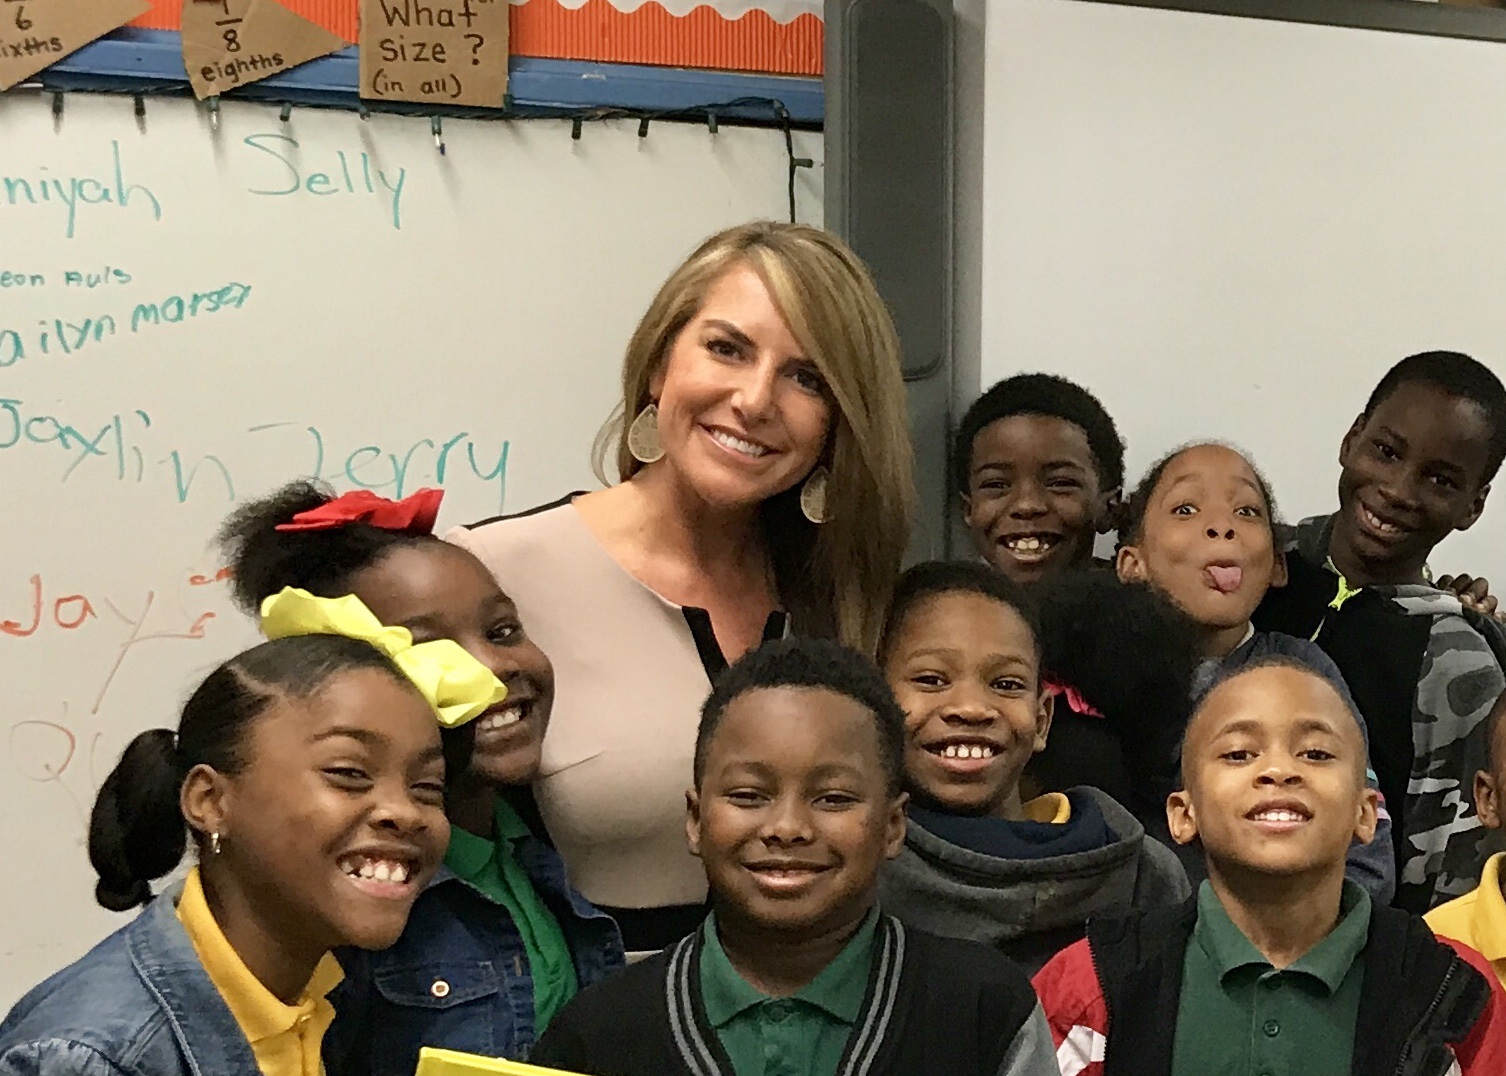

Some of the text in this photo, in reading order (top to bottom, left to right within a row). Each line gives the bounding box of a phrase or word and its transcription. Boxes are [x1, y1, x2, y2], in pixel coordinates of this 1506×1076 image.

[384, 0, 478, 29] What
[0, 36, 64, 57] ixths
[222, 29, 242, 53] 8
[200, 52, 284, 82] eighths
[421, 74, 463, 97] all)
[243, 133, 406, 231] Selly
